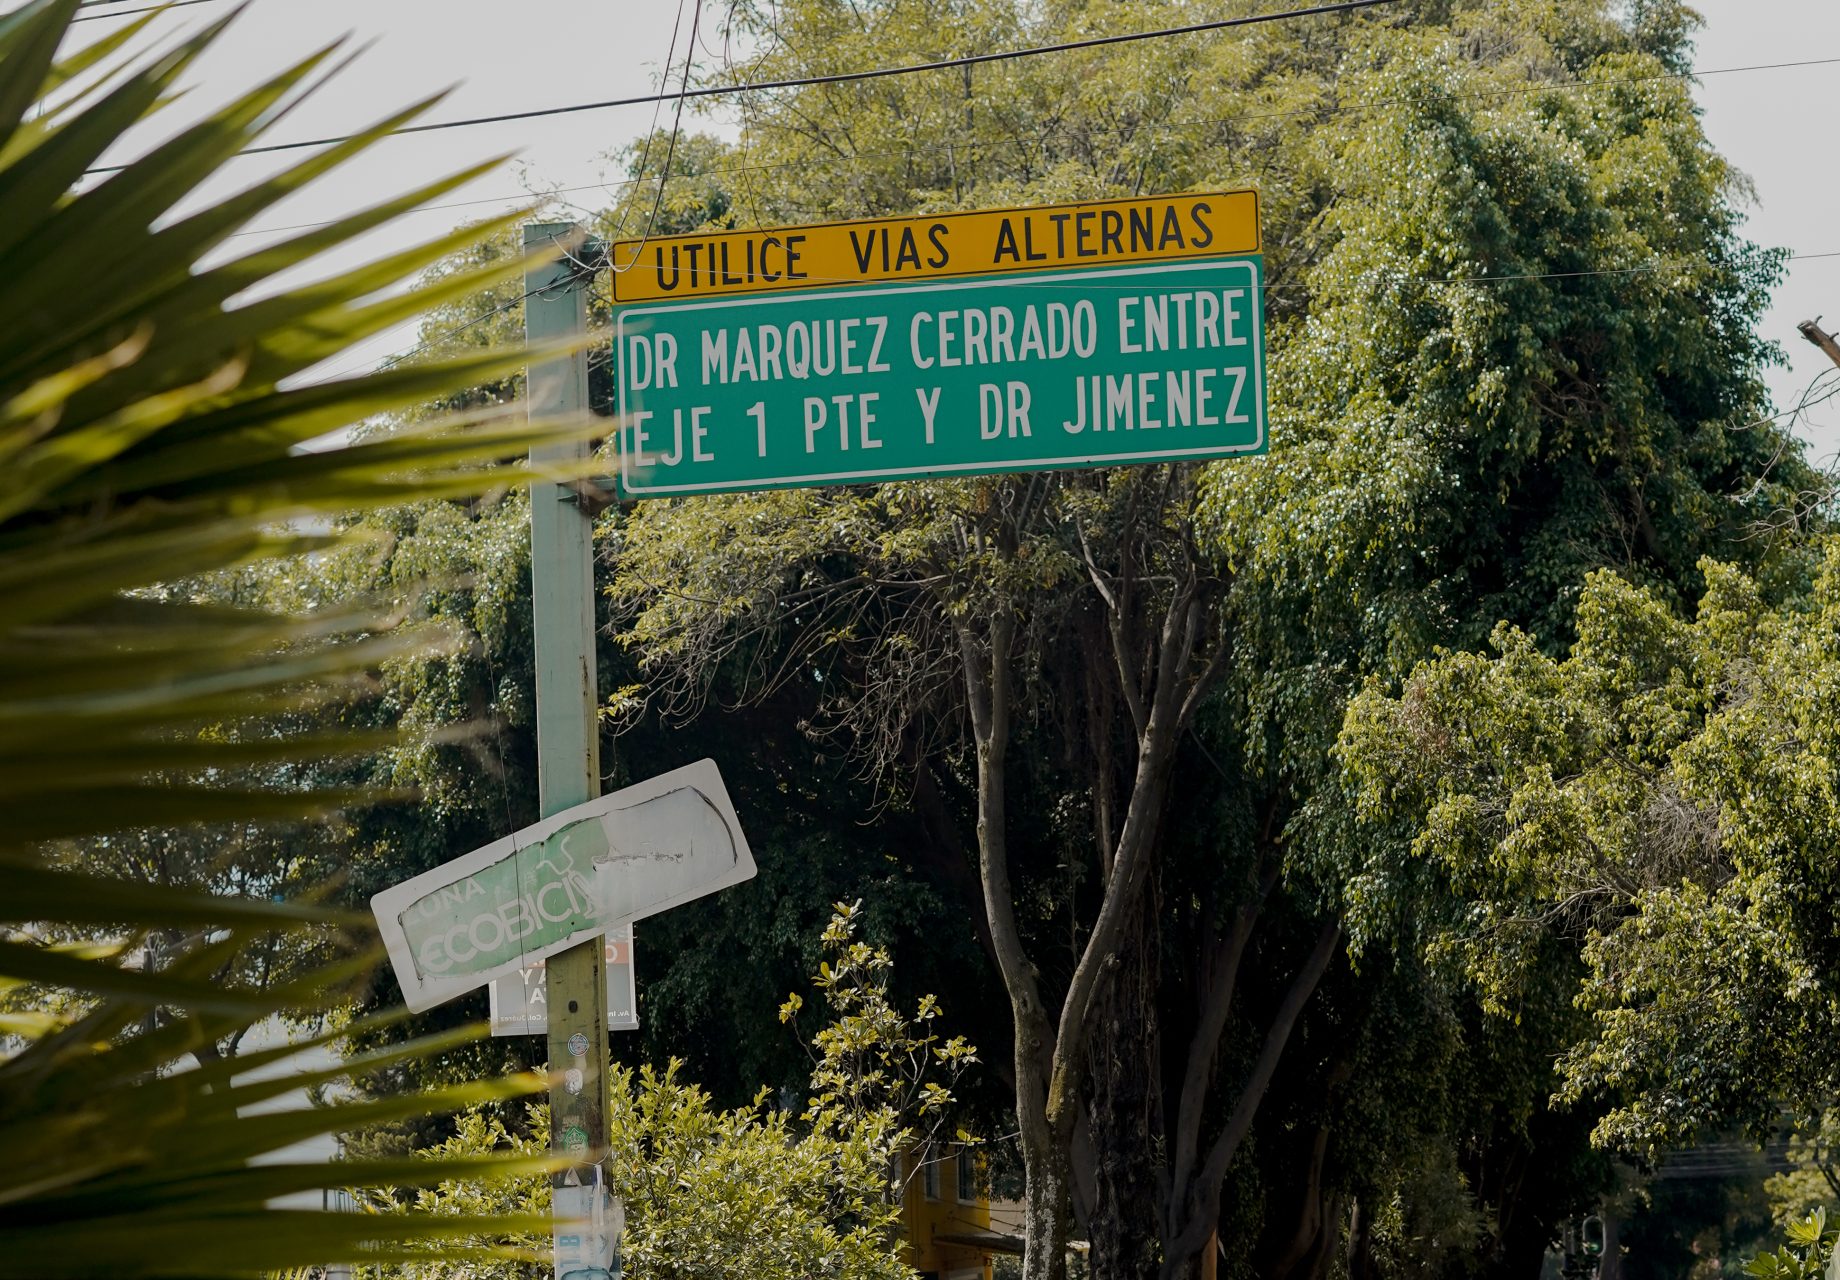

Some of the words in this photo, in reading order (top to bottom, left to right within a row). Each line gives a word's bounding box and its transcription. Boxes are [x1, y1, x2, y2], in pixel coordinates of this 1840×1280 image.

[656, 236, 808, 291] UTILICE
[849, 223, 950, 274] VIAS
[994, 203, 1214, 263] ALTERNAS
[629, 332, 678, 391] DR
[701, 316, 891, 385] MARQUEZ
[910, 300, 1097, 369] CERRADO
[1119, 289, 1248, 354] ENTRE
[633, 406, 715, 467] EJE
[747, 401, 768, 457] 1
[804, 393, 884, 454] PTE
[916, 387, 943, 444] Y
[980, 380, 1032, 440] DR
[1063, 366, 1250, 435] JIMENEZ
